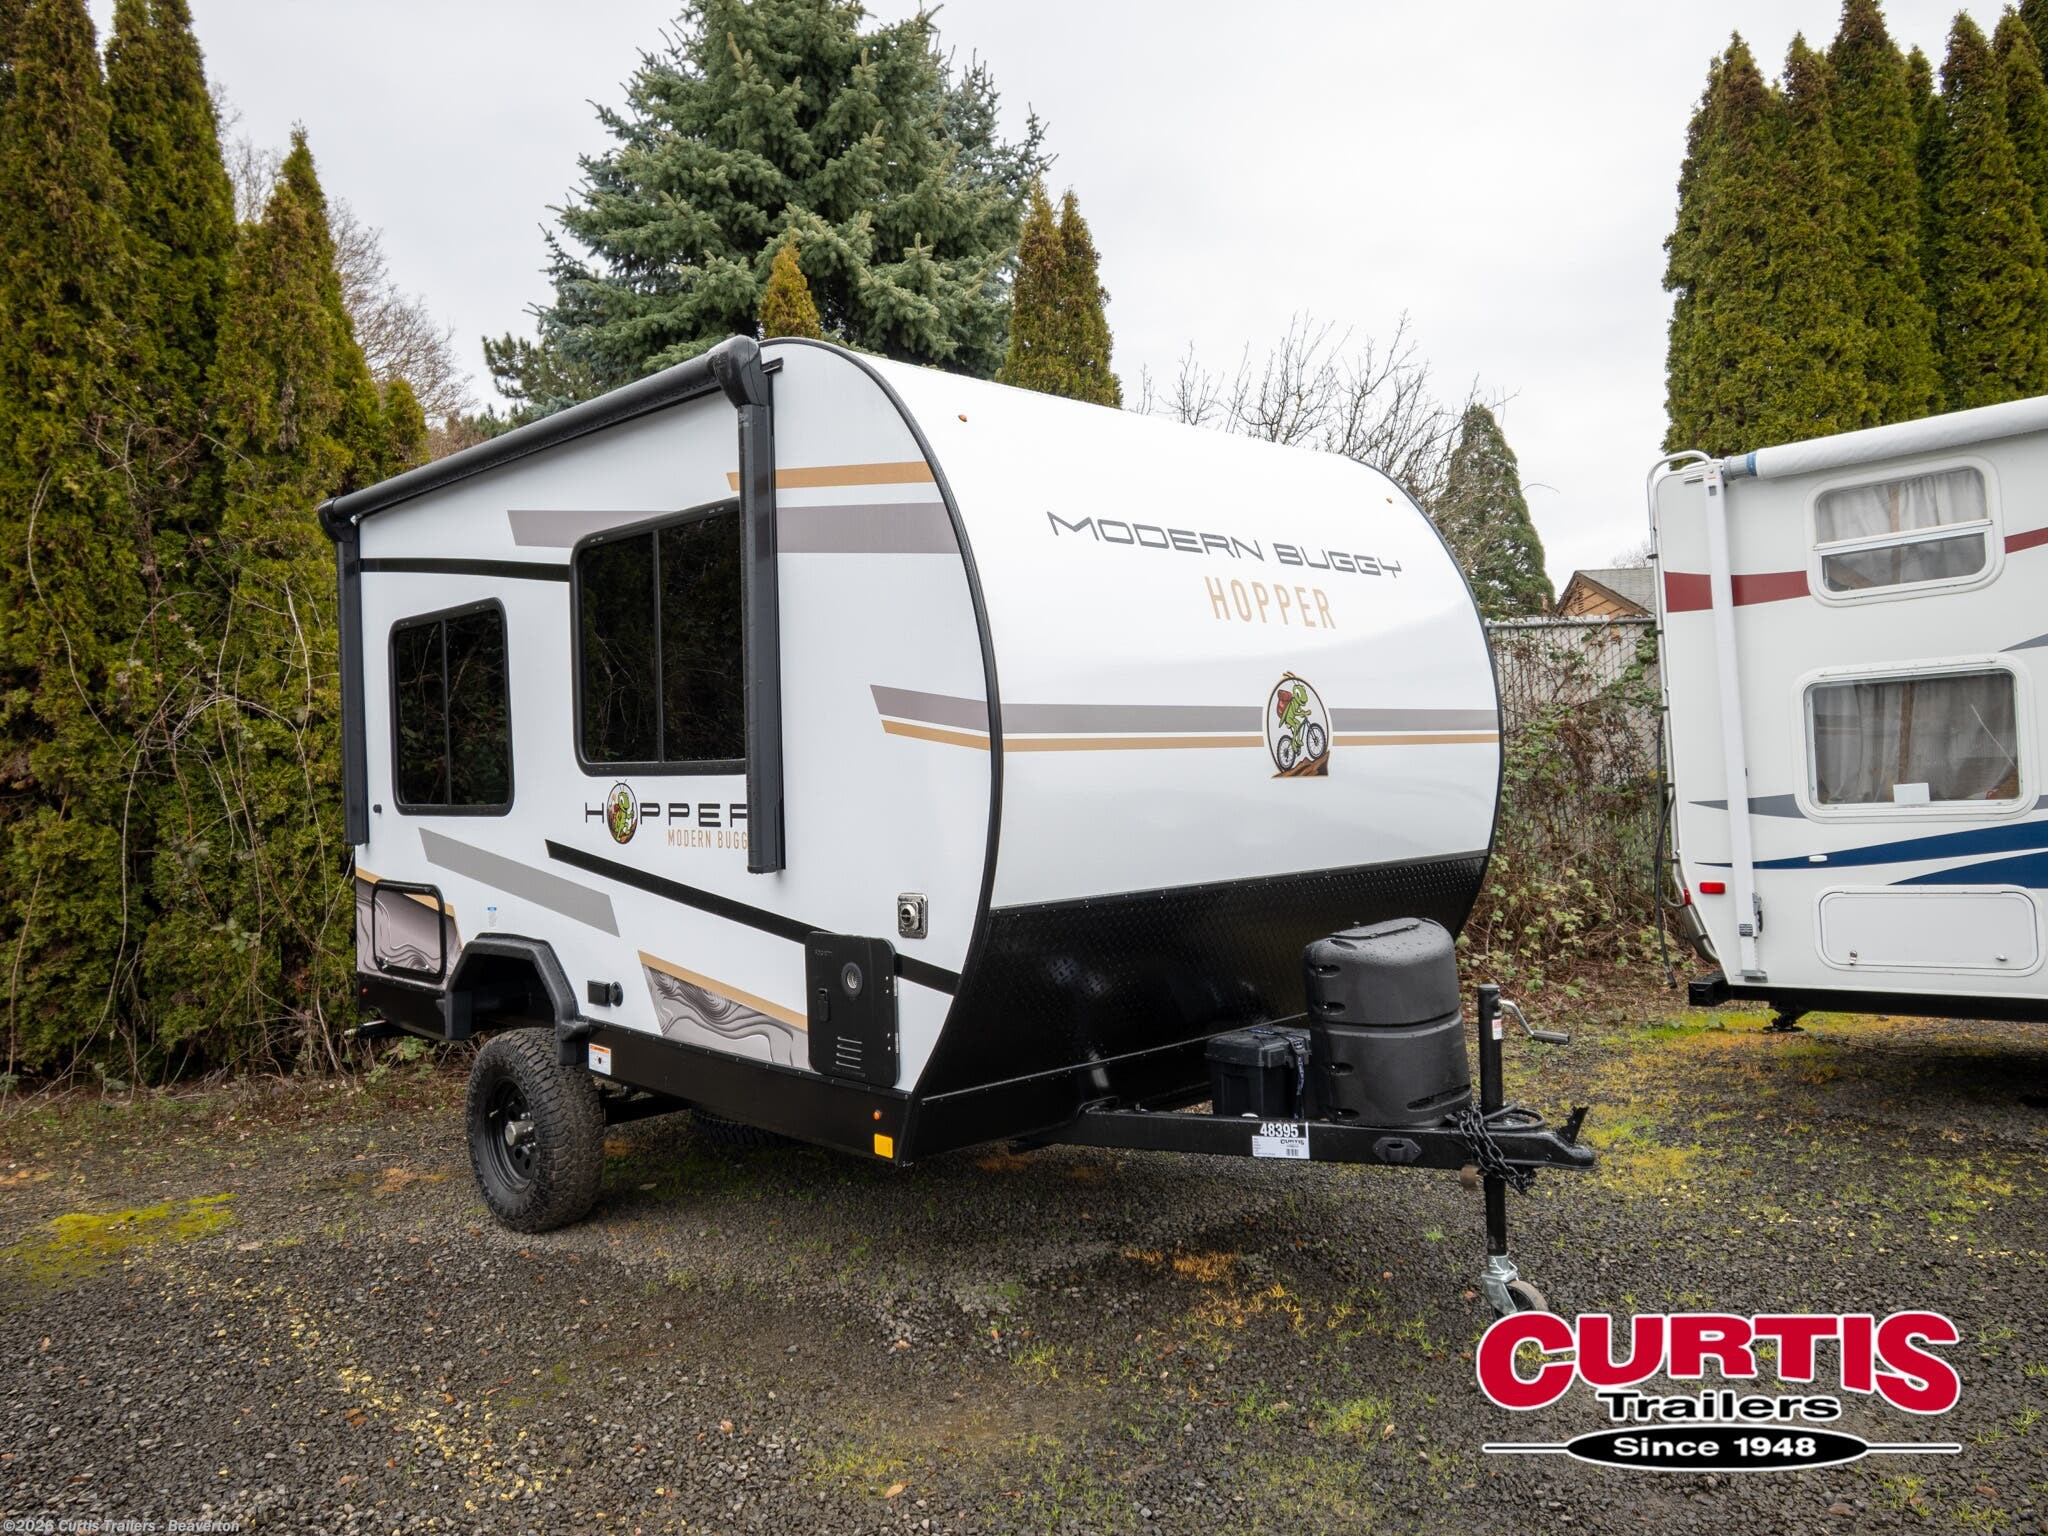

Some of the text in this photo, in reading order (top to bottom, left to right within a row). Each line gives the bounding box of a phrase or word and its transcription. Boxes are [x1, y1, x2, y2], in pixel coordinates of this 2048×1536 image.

[1046, 511, 1402, 578] MODERN BUGGY
[1204, 576, 1336, 629] HOPPER
[668, 830, 748, 849] MODERN BUGG
[1260, 1122, 1299, 1137] 48395
